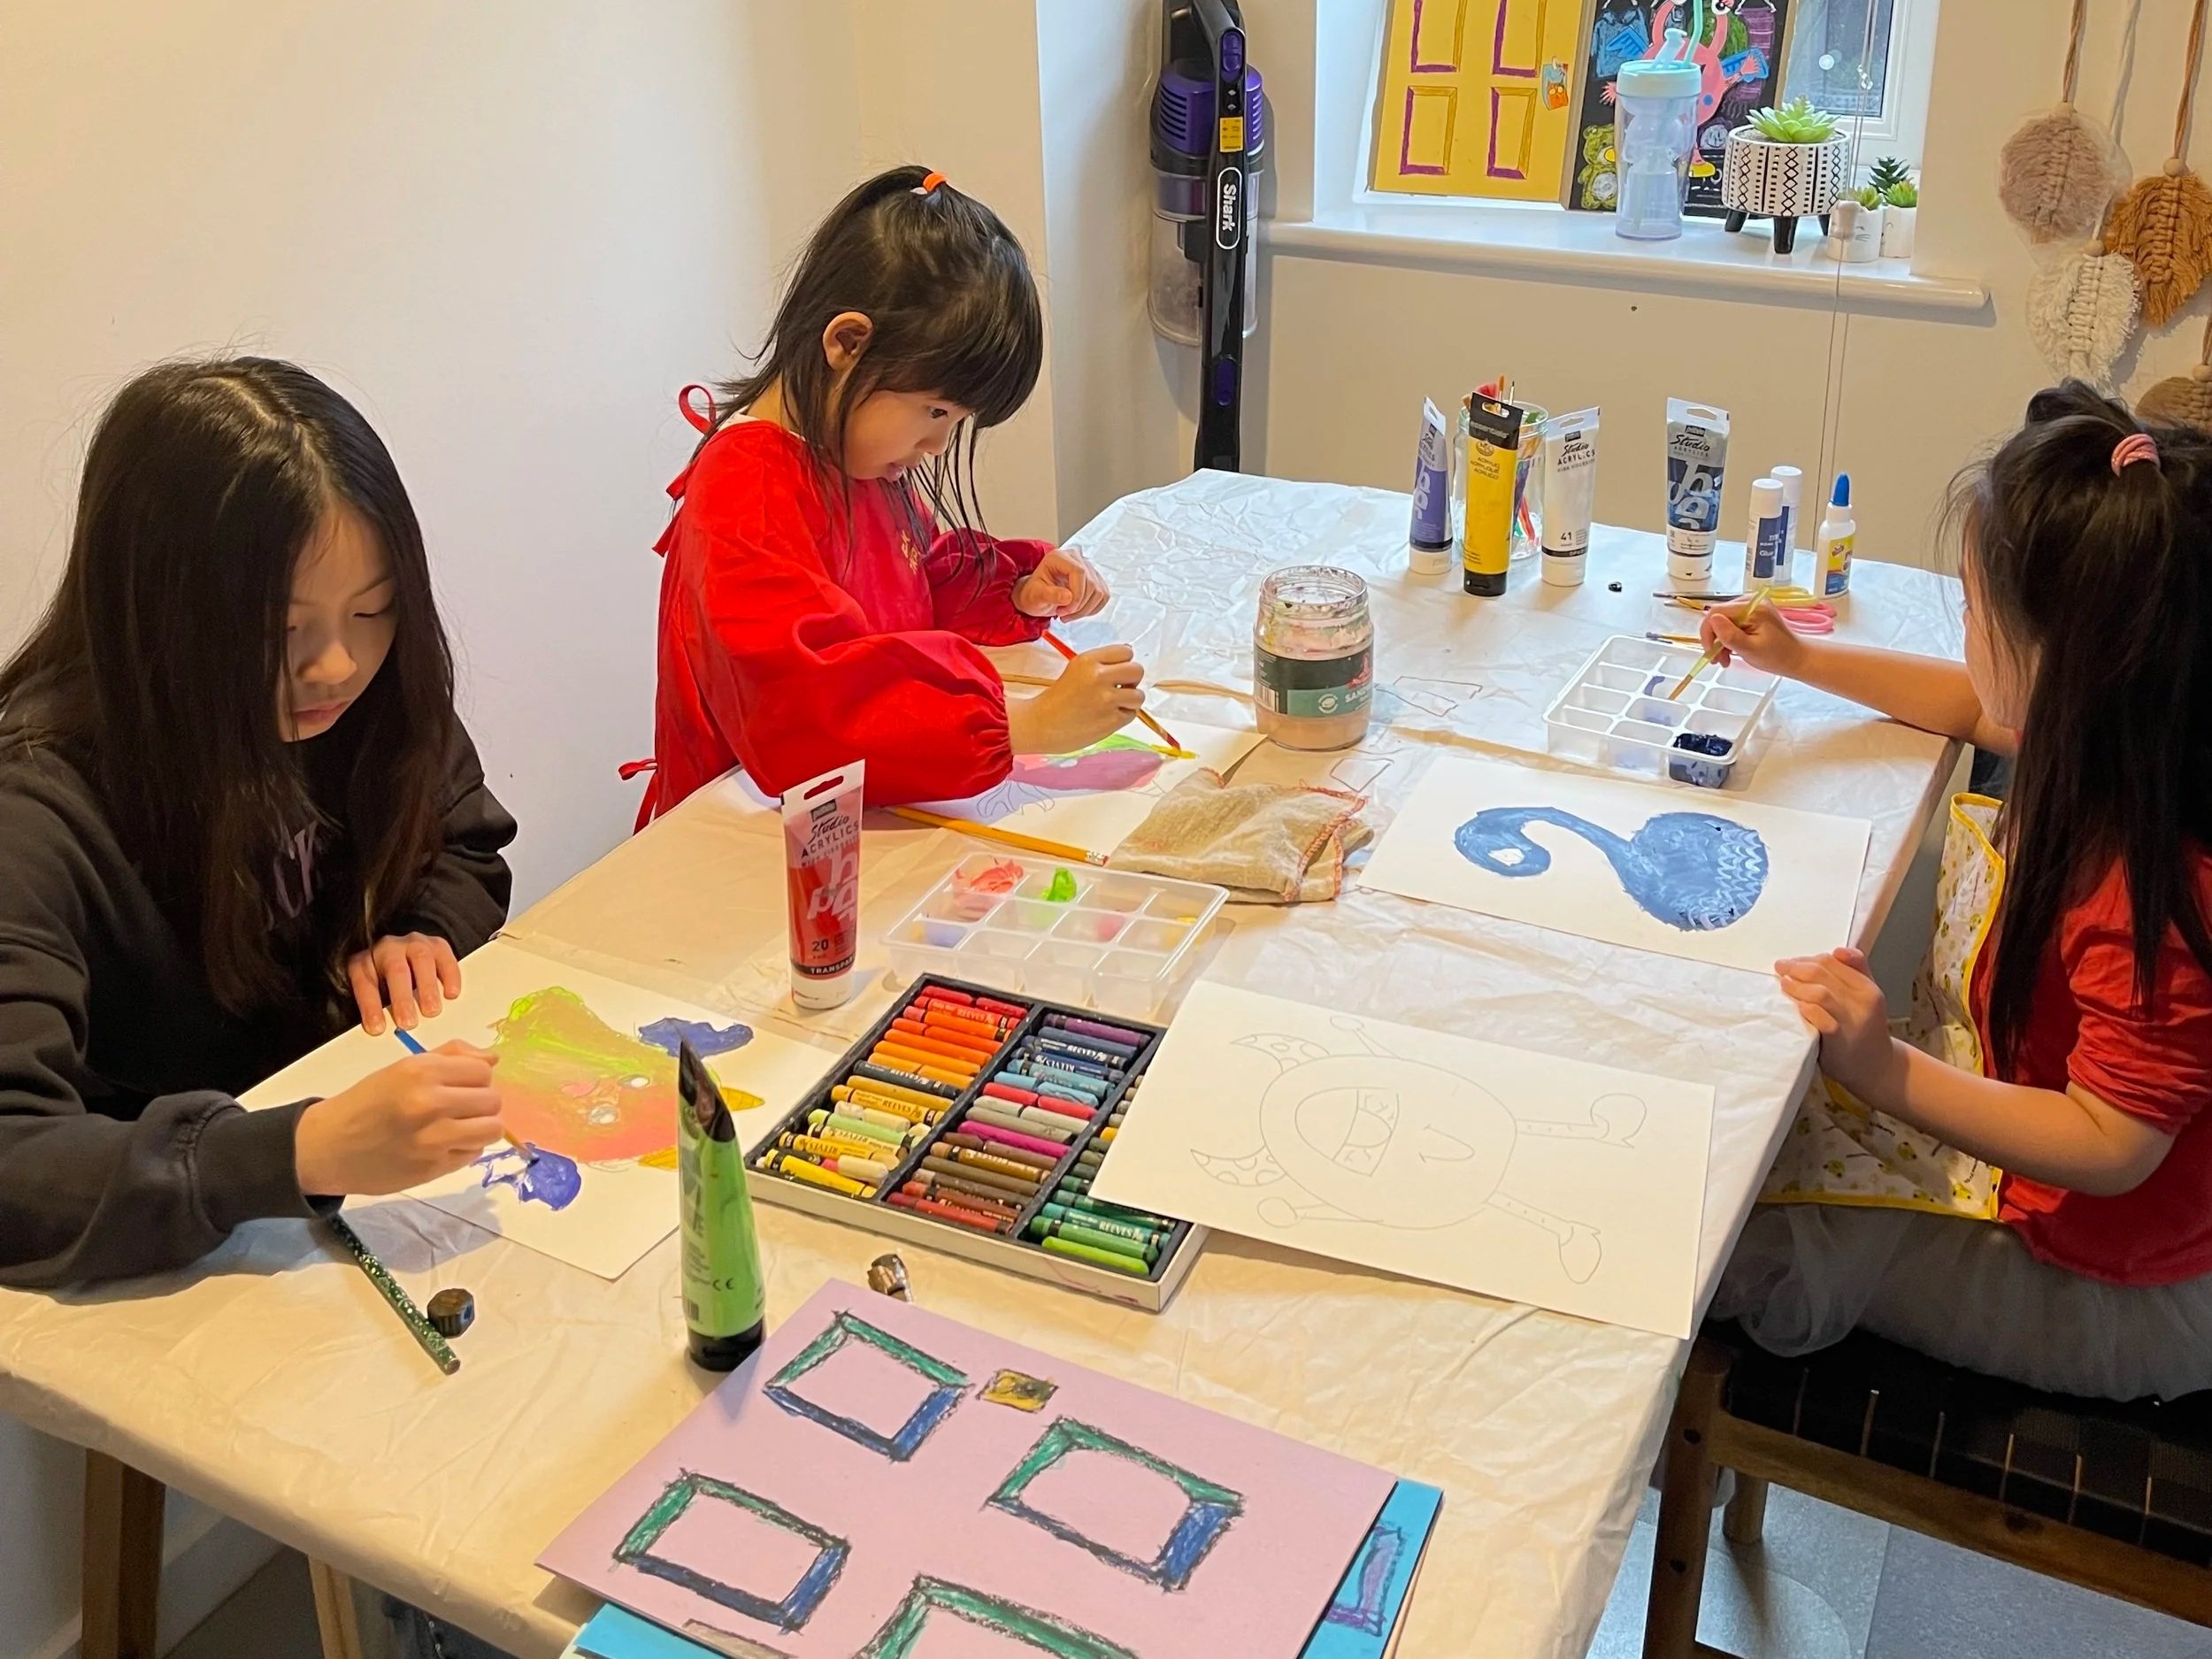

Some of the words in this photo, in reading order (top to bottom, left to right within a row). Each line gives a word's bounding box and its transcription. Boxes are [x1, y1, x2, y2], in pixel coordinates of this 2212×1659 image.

[1223, 183, 1236, 232] Shark
[1561, 442, 1589, 457] Studio
[1670, 434, 1710, 451] Studio
[1557, 449, 1595, 465] ACRYLICS
[1560, 532, 1571, 541] 41
[808, 816, 849, 845] Studio
[801, 821, 859, 858] ACRYLICS
[812, 938, 829, 951] 20
[882, 1100, 911, 1112] REEVES
[1099, 1220, 1133, 1238] REEVES
